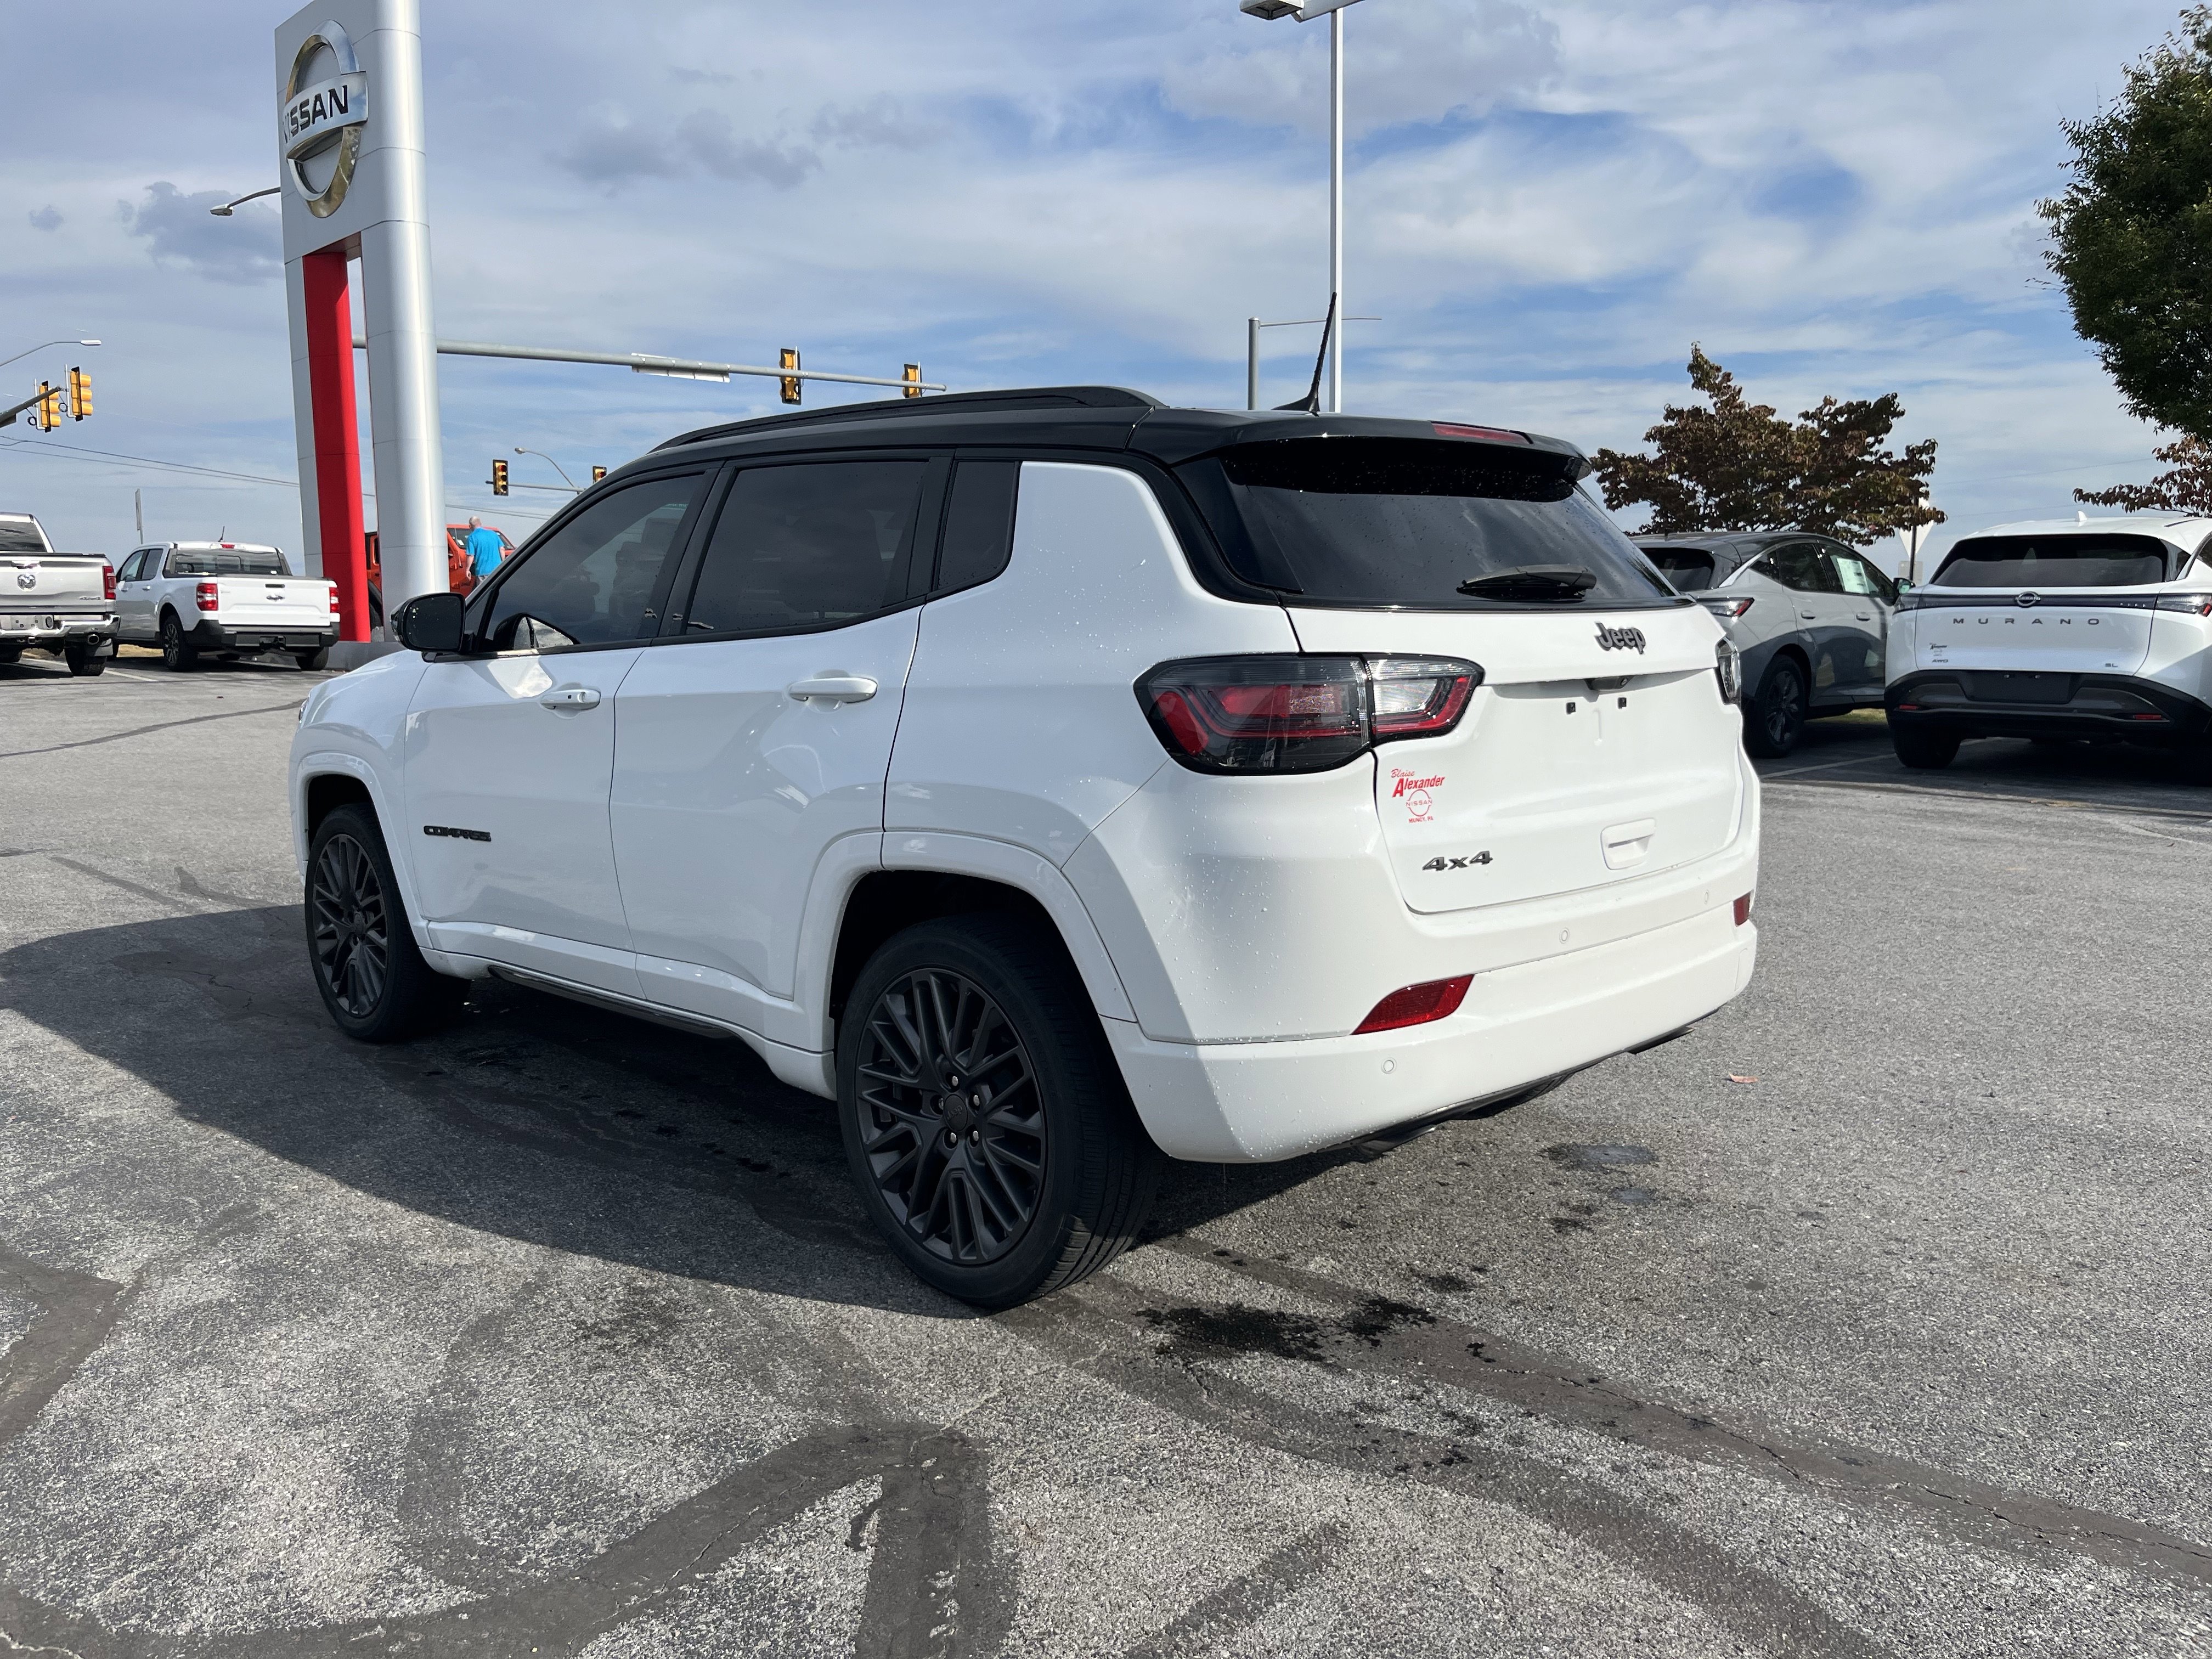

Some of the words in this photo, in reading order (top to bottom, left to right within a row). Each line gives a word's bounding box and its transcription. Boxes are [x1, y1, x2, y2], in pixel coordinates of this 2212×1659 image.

[1594, 622, 1646, 655] Jeep
[1391, 769, 1415, 778] Blaise
[1392, 775, 1445, 797] Alexander
[1422, 850, 1493, 871] 4x4
